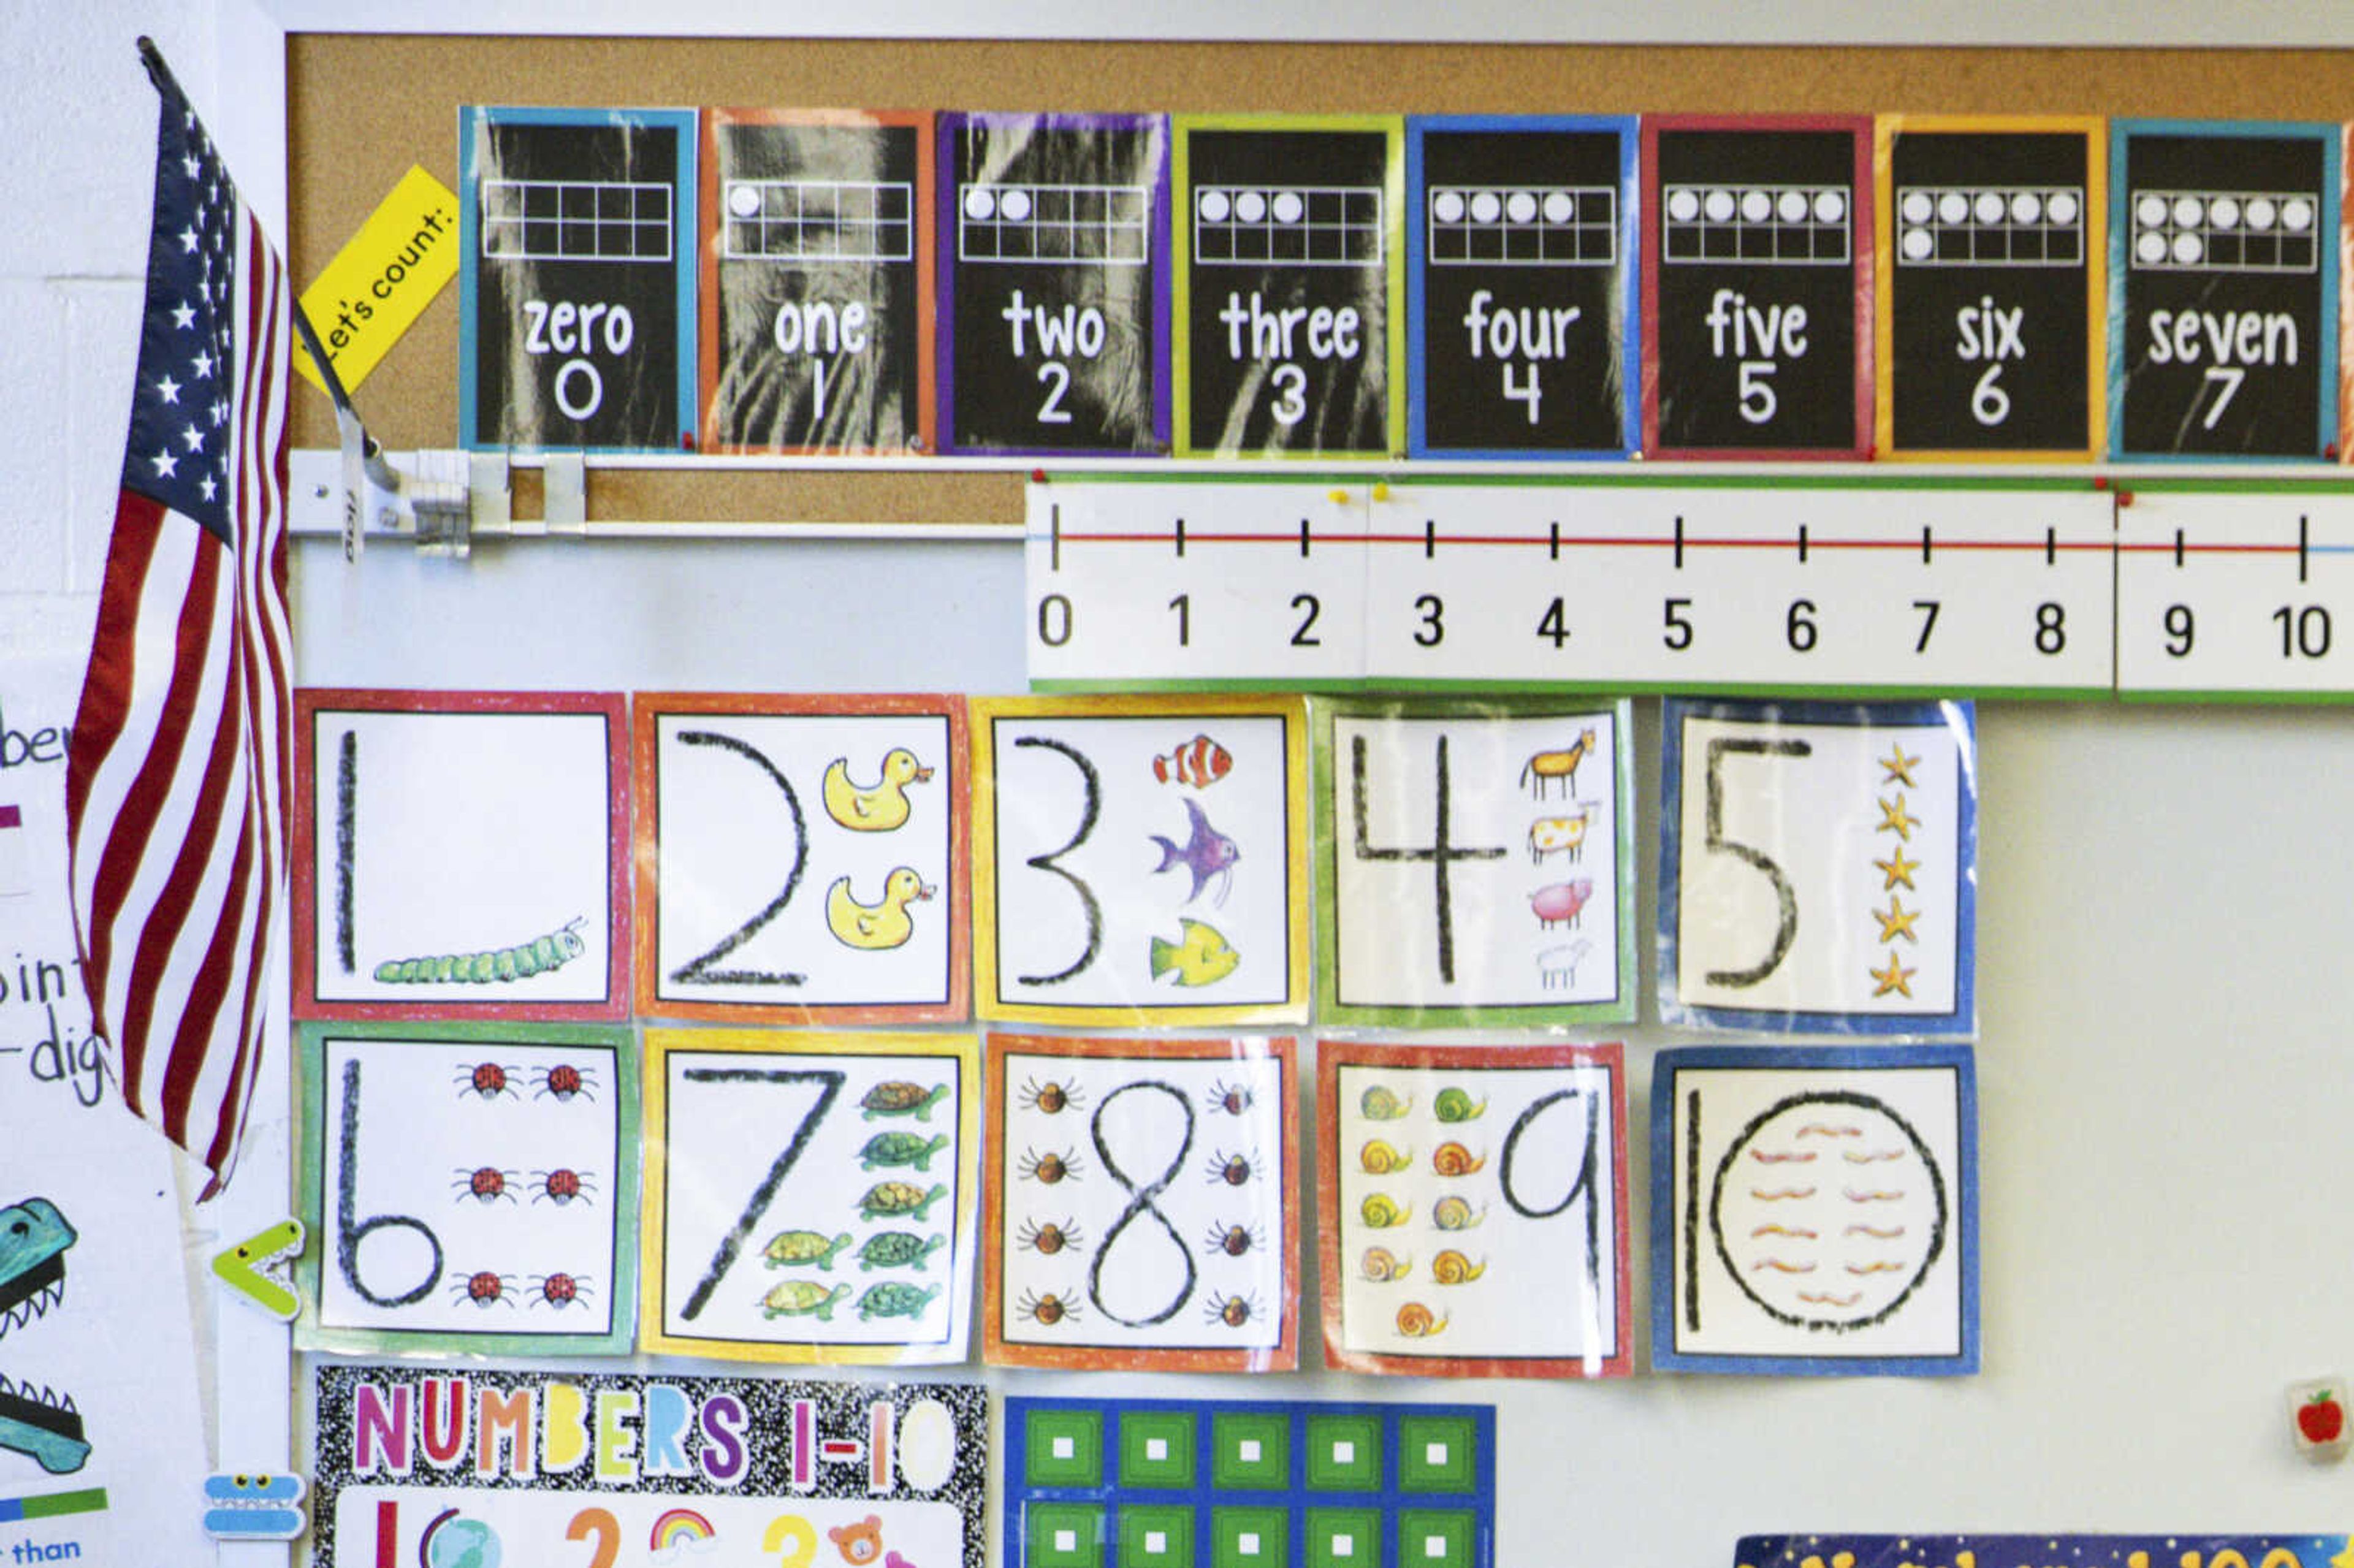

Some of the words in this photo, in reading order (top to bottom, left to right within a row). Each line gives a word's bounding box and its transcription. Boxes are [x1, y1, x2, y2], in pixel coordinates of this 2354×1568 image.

[371, 207, 454, 299] count:
[523, 300, 633, 355] zero
[774, 300, 867, 354] one
[1002, 291, 1105, 357] two
[1219, 292, 1359, 359] three
[1464, 291, 1580, 358] four
[1707, 291, 1807, 356] five
[1958, 298, 2024, 358] six
[2150, 311, 2296, 363] seven
[555, 359, 603, 420] 0
[813, 359, 825, 420] 1
[1038, 362, 1072, 422] 2
[1271, 365, 1306, 426] 3
[1504, 364, 1541, 423] 4
[1740, 363, 1776, 422] 5
[1973, 365, 2009, 424] 6
[2205, 369, 2243, 427] 7
[1038, 594, 1073, 647] 0
[1168, 593, 1190, 647] 1
[1290, 593, 1322, 647] 2
[1412, 593, 1445, 649] 3
[1536, 596, 1572, 650] 4
[1663, 598, 1694, 652] 5
[1786, 598, 1819, 653] 6
[1912, 600, 1941, 654] 7
[2034, 601, 2067, 657] 8
[2163, 603, 2195, 659] 9
[2272, 605, 2332, 660] 10
[671, 730, 810, 986] 2
[1013, 736, 1101, 988] 3
[1351, 734, 1508, 984] 4
[1705, 737, 1813, 988] 5
[337, 1059, 444, 1309] 6
[680, 1068, 847, 1322] 7
[1088, 1080, 1198, 1325] 8
[1499, 1089, 1600, 1320] 9
[1683, 1088, 1949, 1333] 10
[354, 1379, 746, 1481] NUMBERS
[793, 1399, 957, 1490] 1-10
[12, 1538, 81, 1566] than
